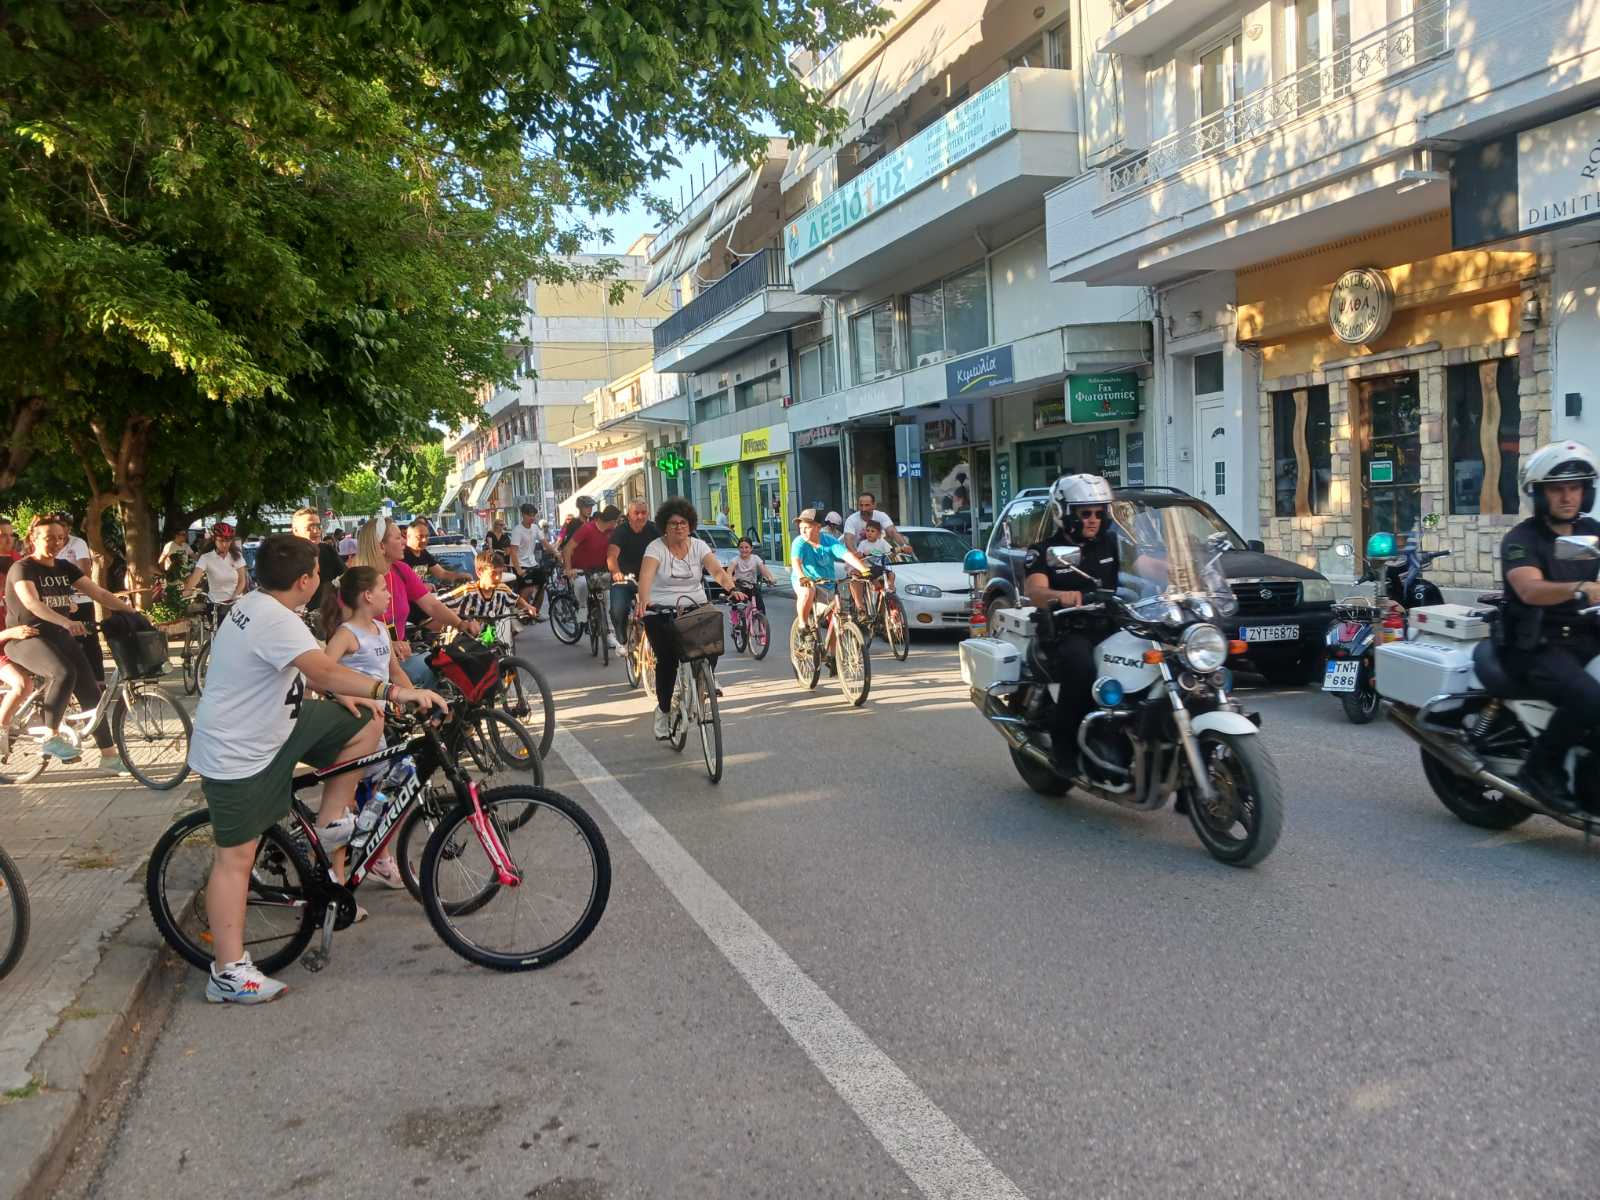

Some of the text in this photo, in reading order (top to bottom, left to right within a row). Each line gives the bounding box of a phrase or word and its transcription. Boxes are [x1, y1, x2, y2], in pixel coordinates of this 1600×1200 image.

[1581, 137, 1600, 179] RO
[1075, 387, 1135, 402] Φωτοτυπίες
[1098, 384, 1112, 392] Fax
[898, 463, 907, 477] P
[39, 575, 71, 588] LOVE
[1103, 653, 1145, 669] SUZUKI
[1332, 675, 1354, 686] 686
[284, 672, 304, 720] 4
[366, 774, 421, 857] MERIDA
